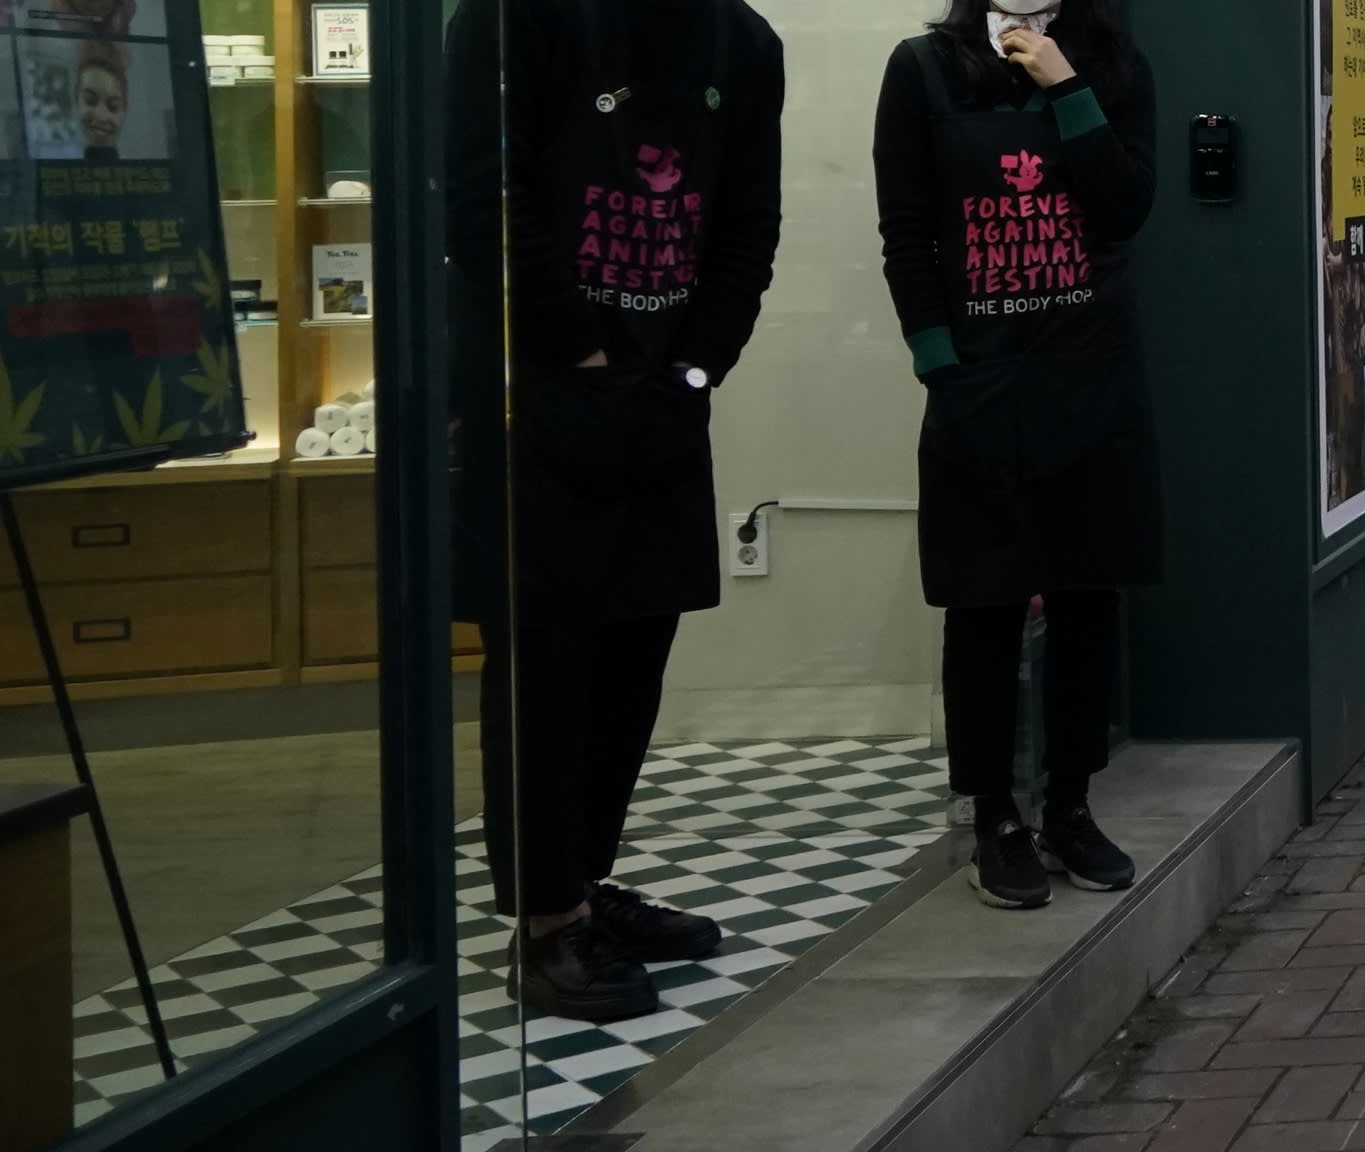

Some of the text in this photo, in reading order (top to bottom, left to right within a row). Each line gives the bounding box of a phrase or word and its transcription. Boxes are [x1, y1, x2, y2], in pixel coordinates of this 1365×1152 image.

[961, 192, 1071, 221] FOREVE
[964, 216, 1088, 246] AGAINST
[1350, 224, 1364, 255] 함께
[965, 239, 1088, 271] ANIMAL
[966, 261, 1090, 294] TESTING
[965, 299, 998, 316] THE
[1003, 295, 1052, 315] BODY
